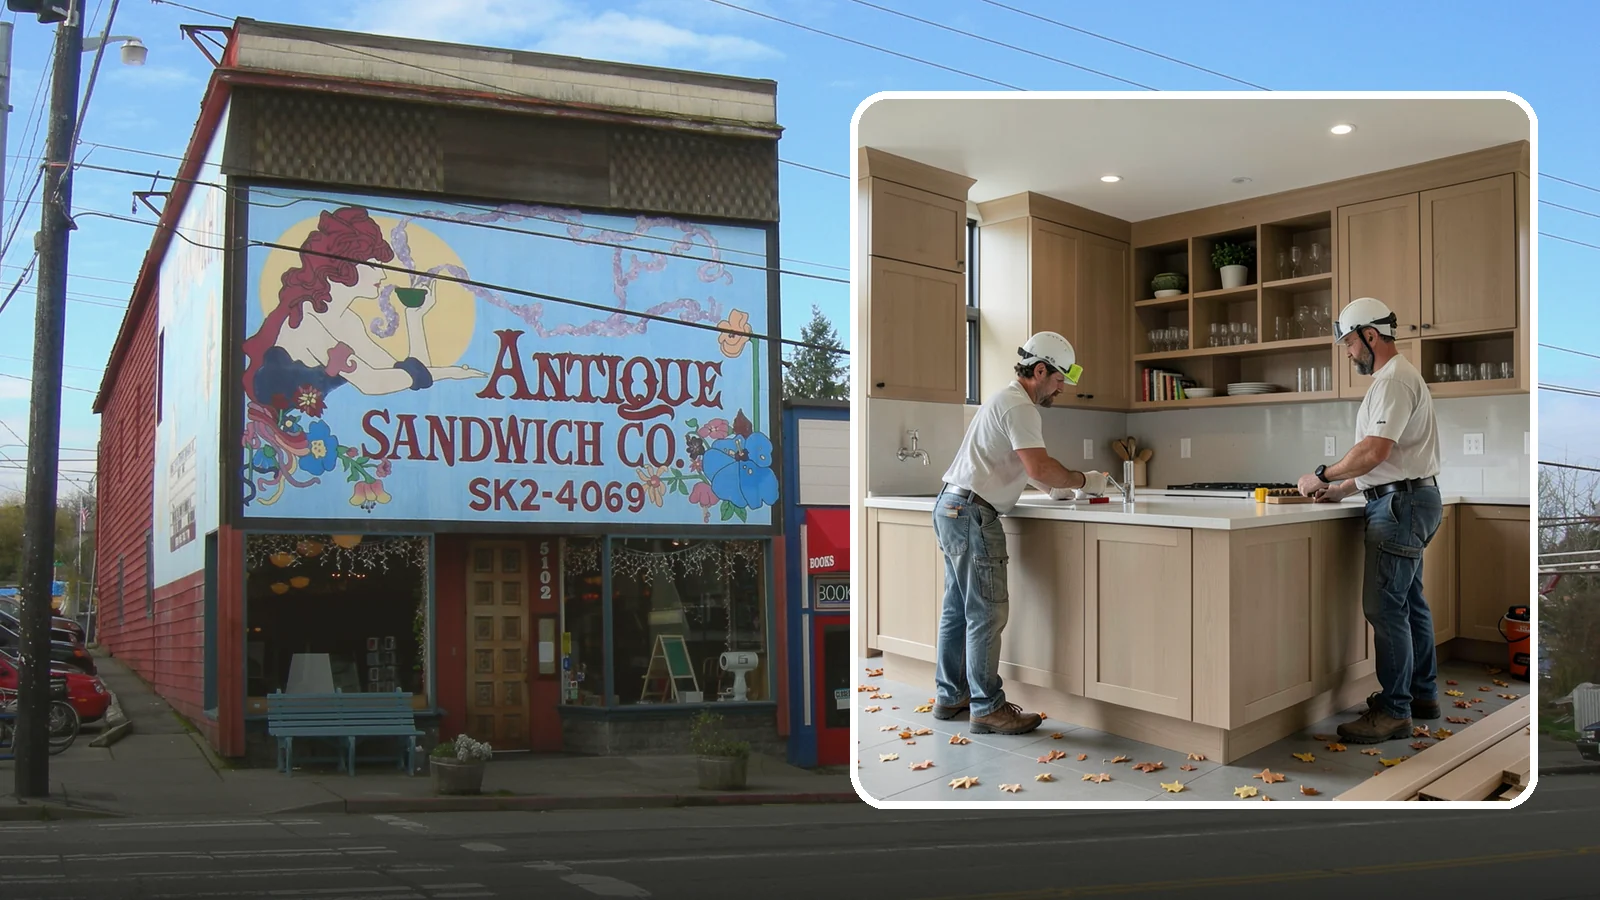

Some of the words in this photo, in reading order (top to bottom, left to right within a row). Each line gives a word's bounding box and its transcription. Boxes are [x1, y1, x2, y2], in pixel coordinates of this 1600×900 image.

[476, 329, 723, 421] ANTIQUE
[361, 409, 604, 467] SANDWICH
[617, 422, 685, 469] CO.
[468, 477, 645, 513] SK2-4069
[539, 542, 551, 599] 5102
[809, 555, 834, 569] BOOKS
